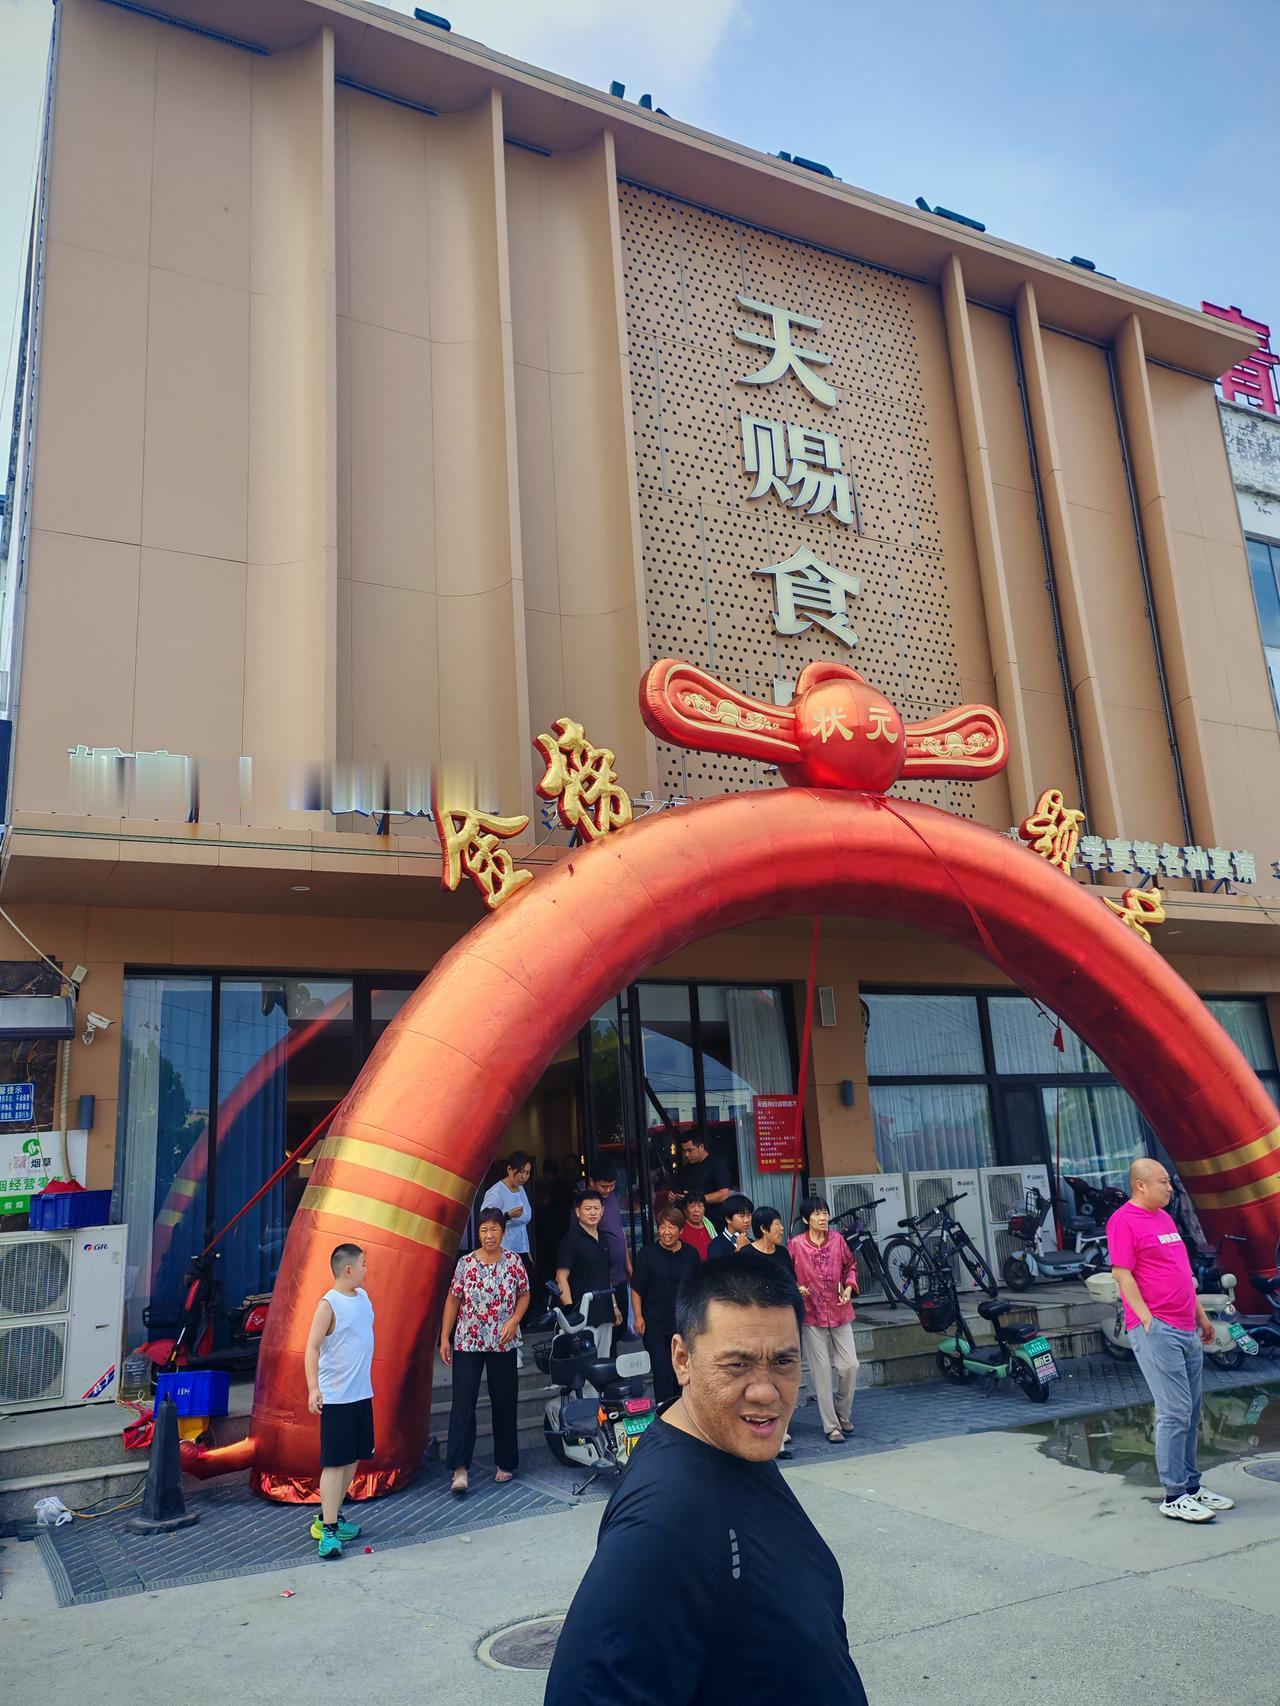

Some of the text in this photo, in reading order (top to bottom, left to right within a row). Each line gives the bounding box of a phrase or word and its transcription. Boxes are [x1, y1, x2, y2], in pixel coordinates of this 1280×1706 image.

[733, 295, 860, 704] 天赐食
[811, 706, 899, 744] 状元
